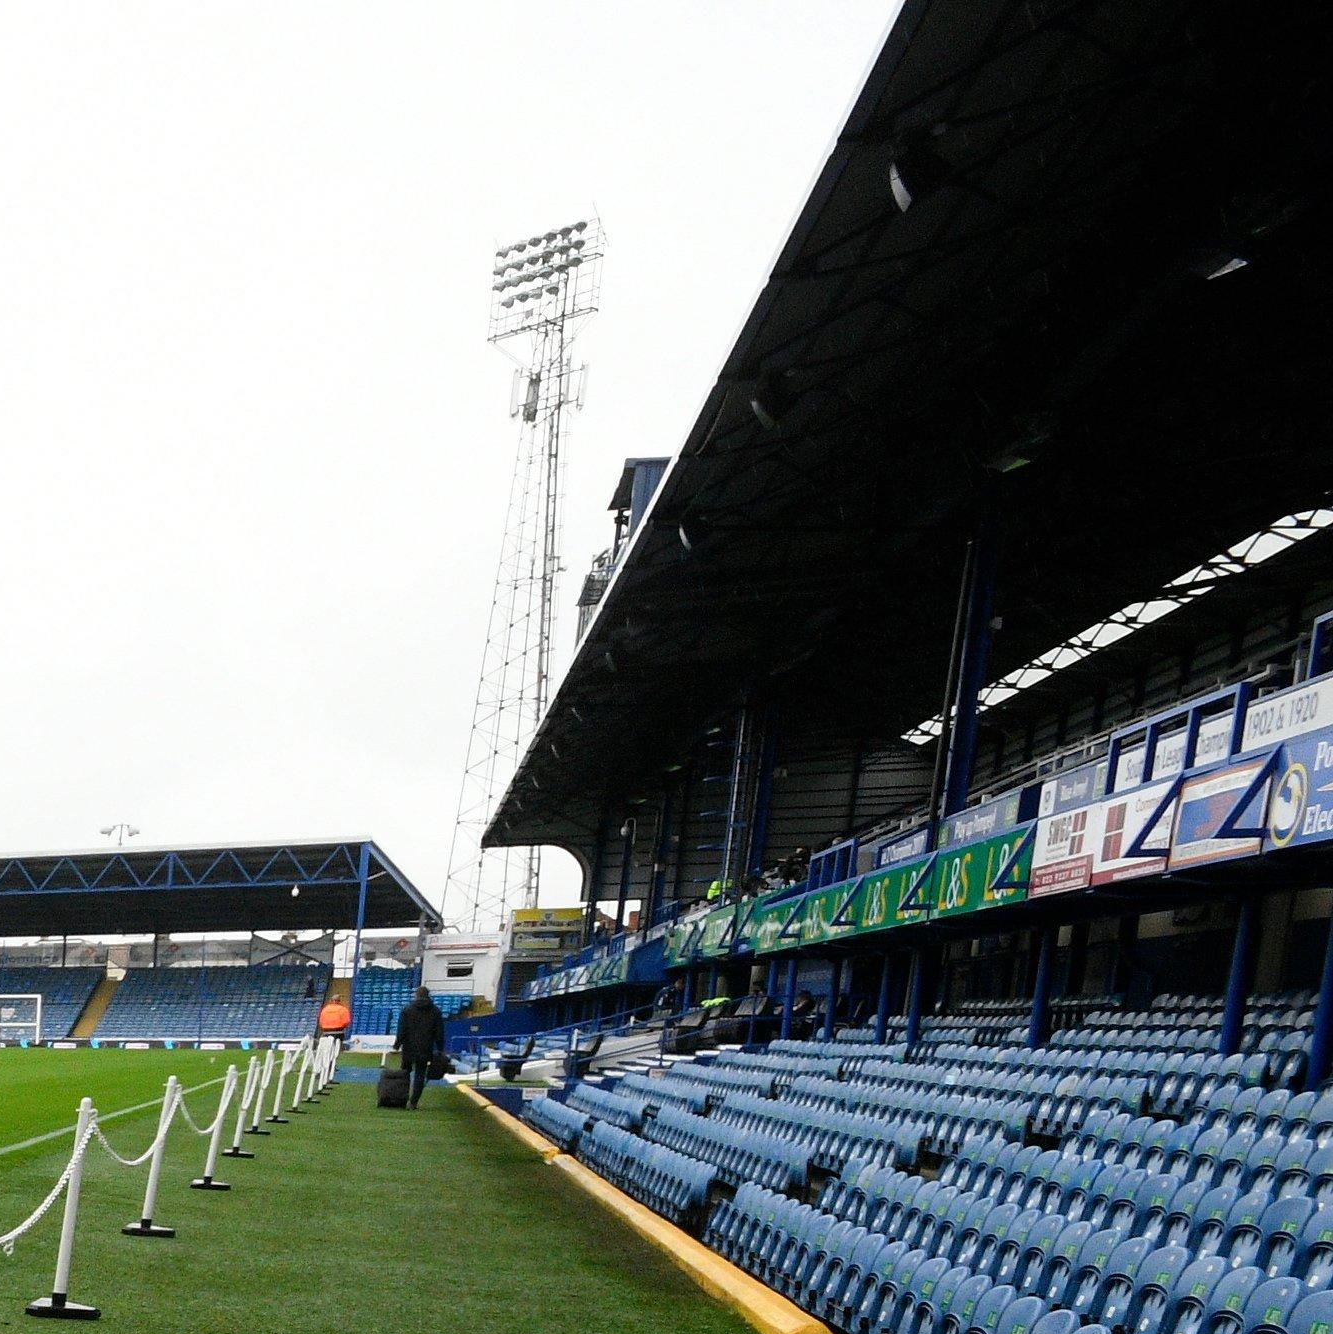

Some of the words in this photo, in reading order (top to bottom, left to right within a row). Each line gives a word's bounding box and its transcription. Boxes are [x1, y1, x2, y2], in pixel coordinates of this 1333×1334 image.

[1247, 708, 1275, 740] 1902
[1276, 704, 1285, 729] &
[1288, 692, 1319, 727] 1920
[862, 877, 890, 928] L&S
[938, 853, 972, 911] L&S
